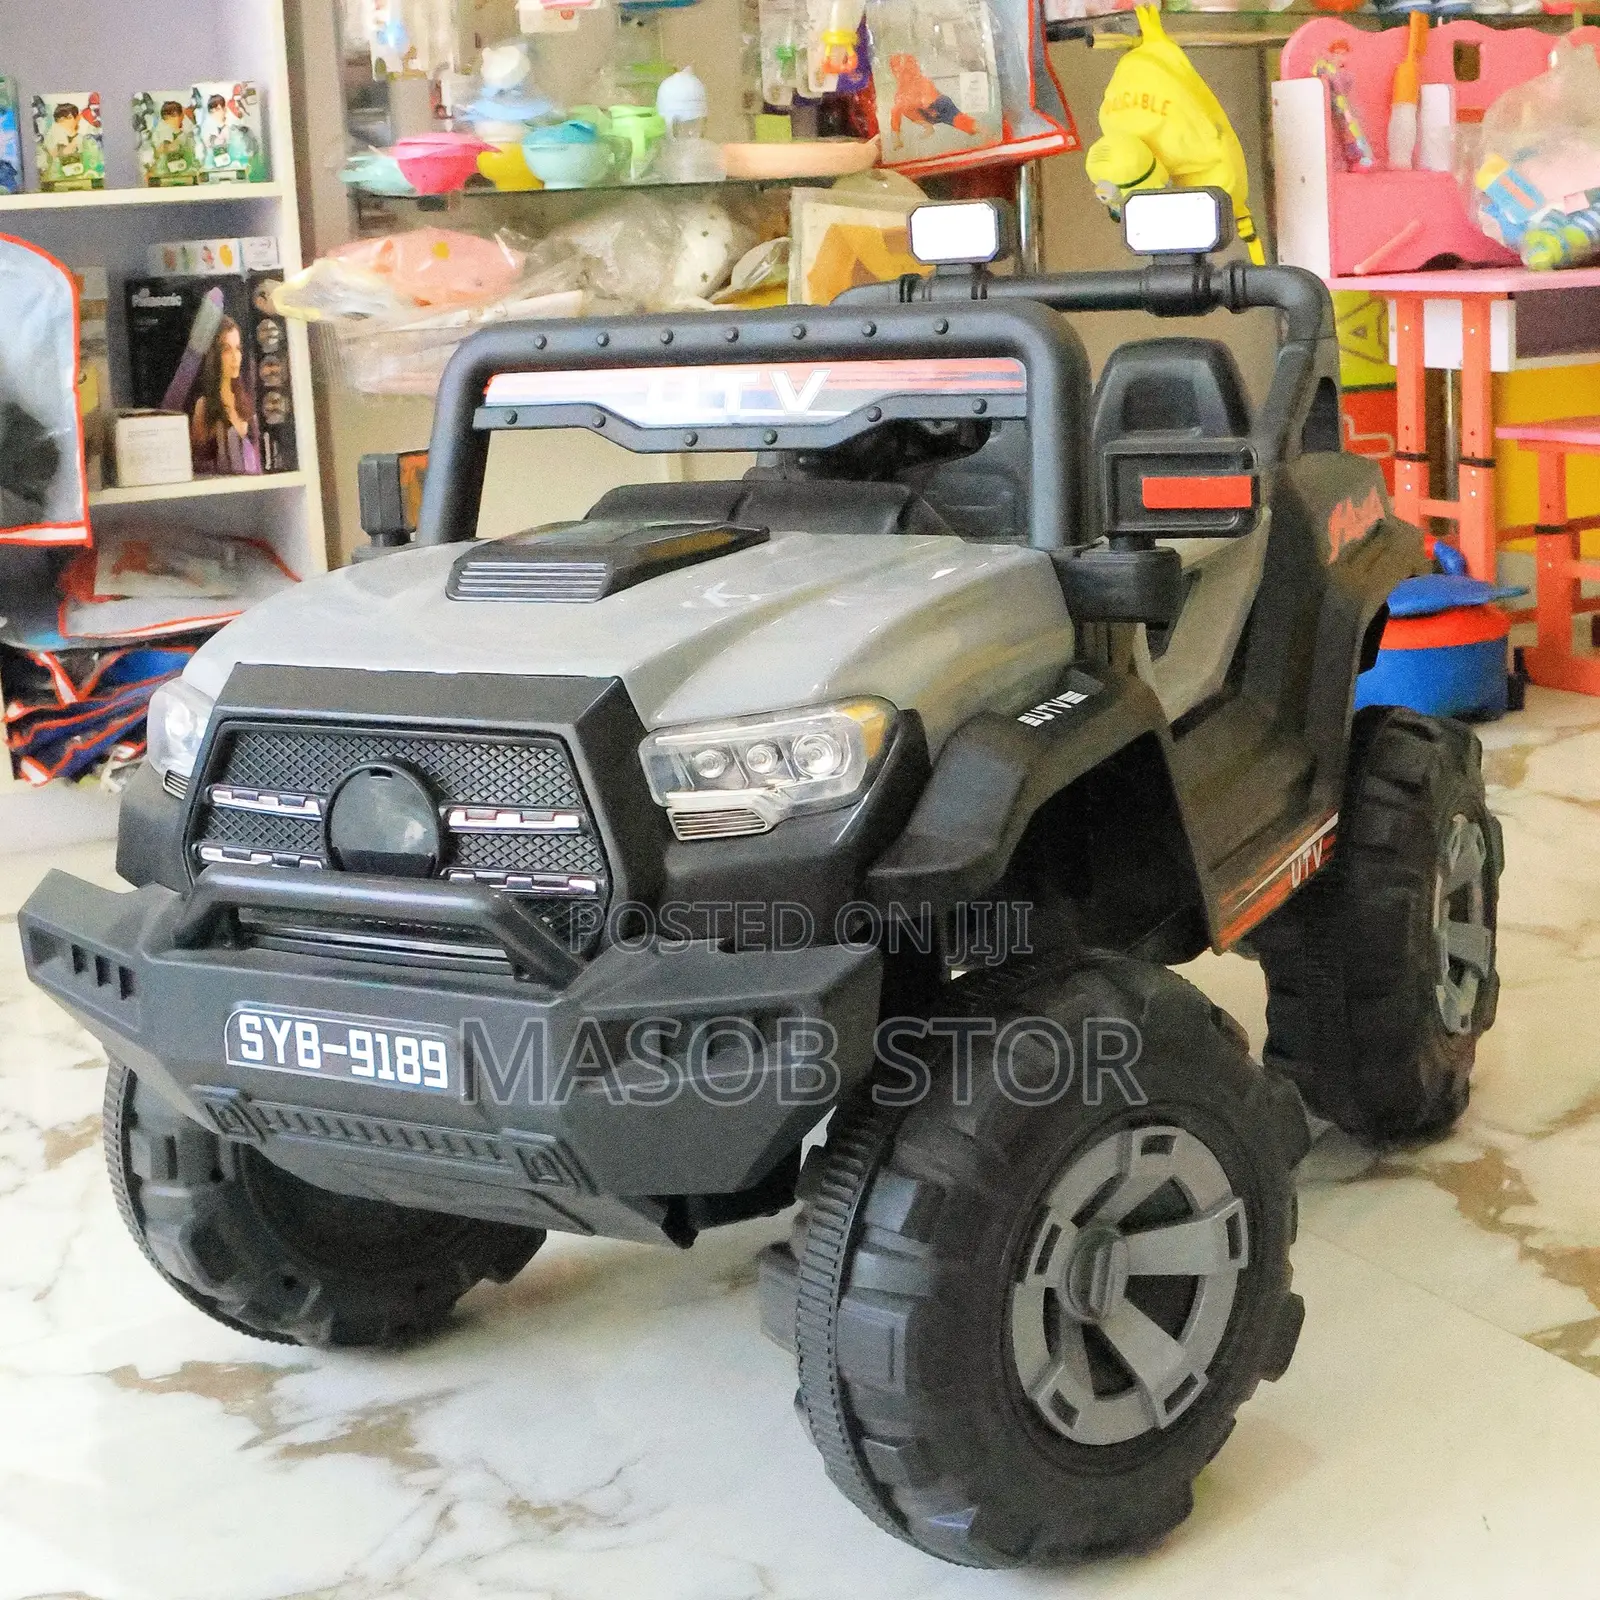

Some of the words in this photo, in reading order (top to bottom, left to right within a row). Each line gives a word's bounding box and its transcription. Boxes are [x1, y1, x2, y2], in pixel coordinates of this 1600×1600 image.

[1024, 698, 1073, 721] UTV
[1291, 836, 1324, 889] UTV
[238, 1013, 449, 1090] SYB-9189
